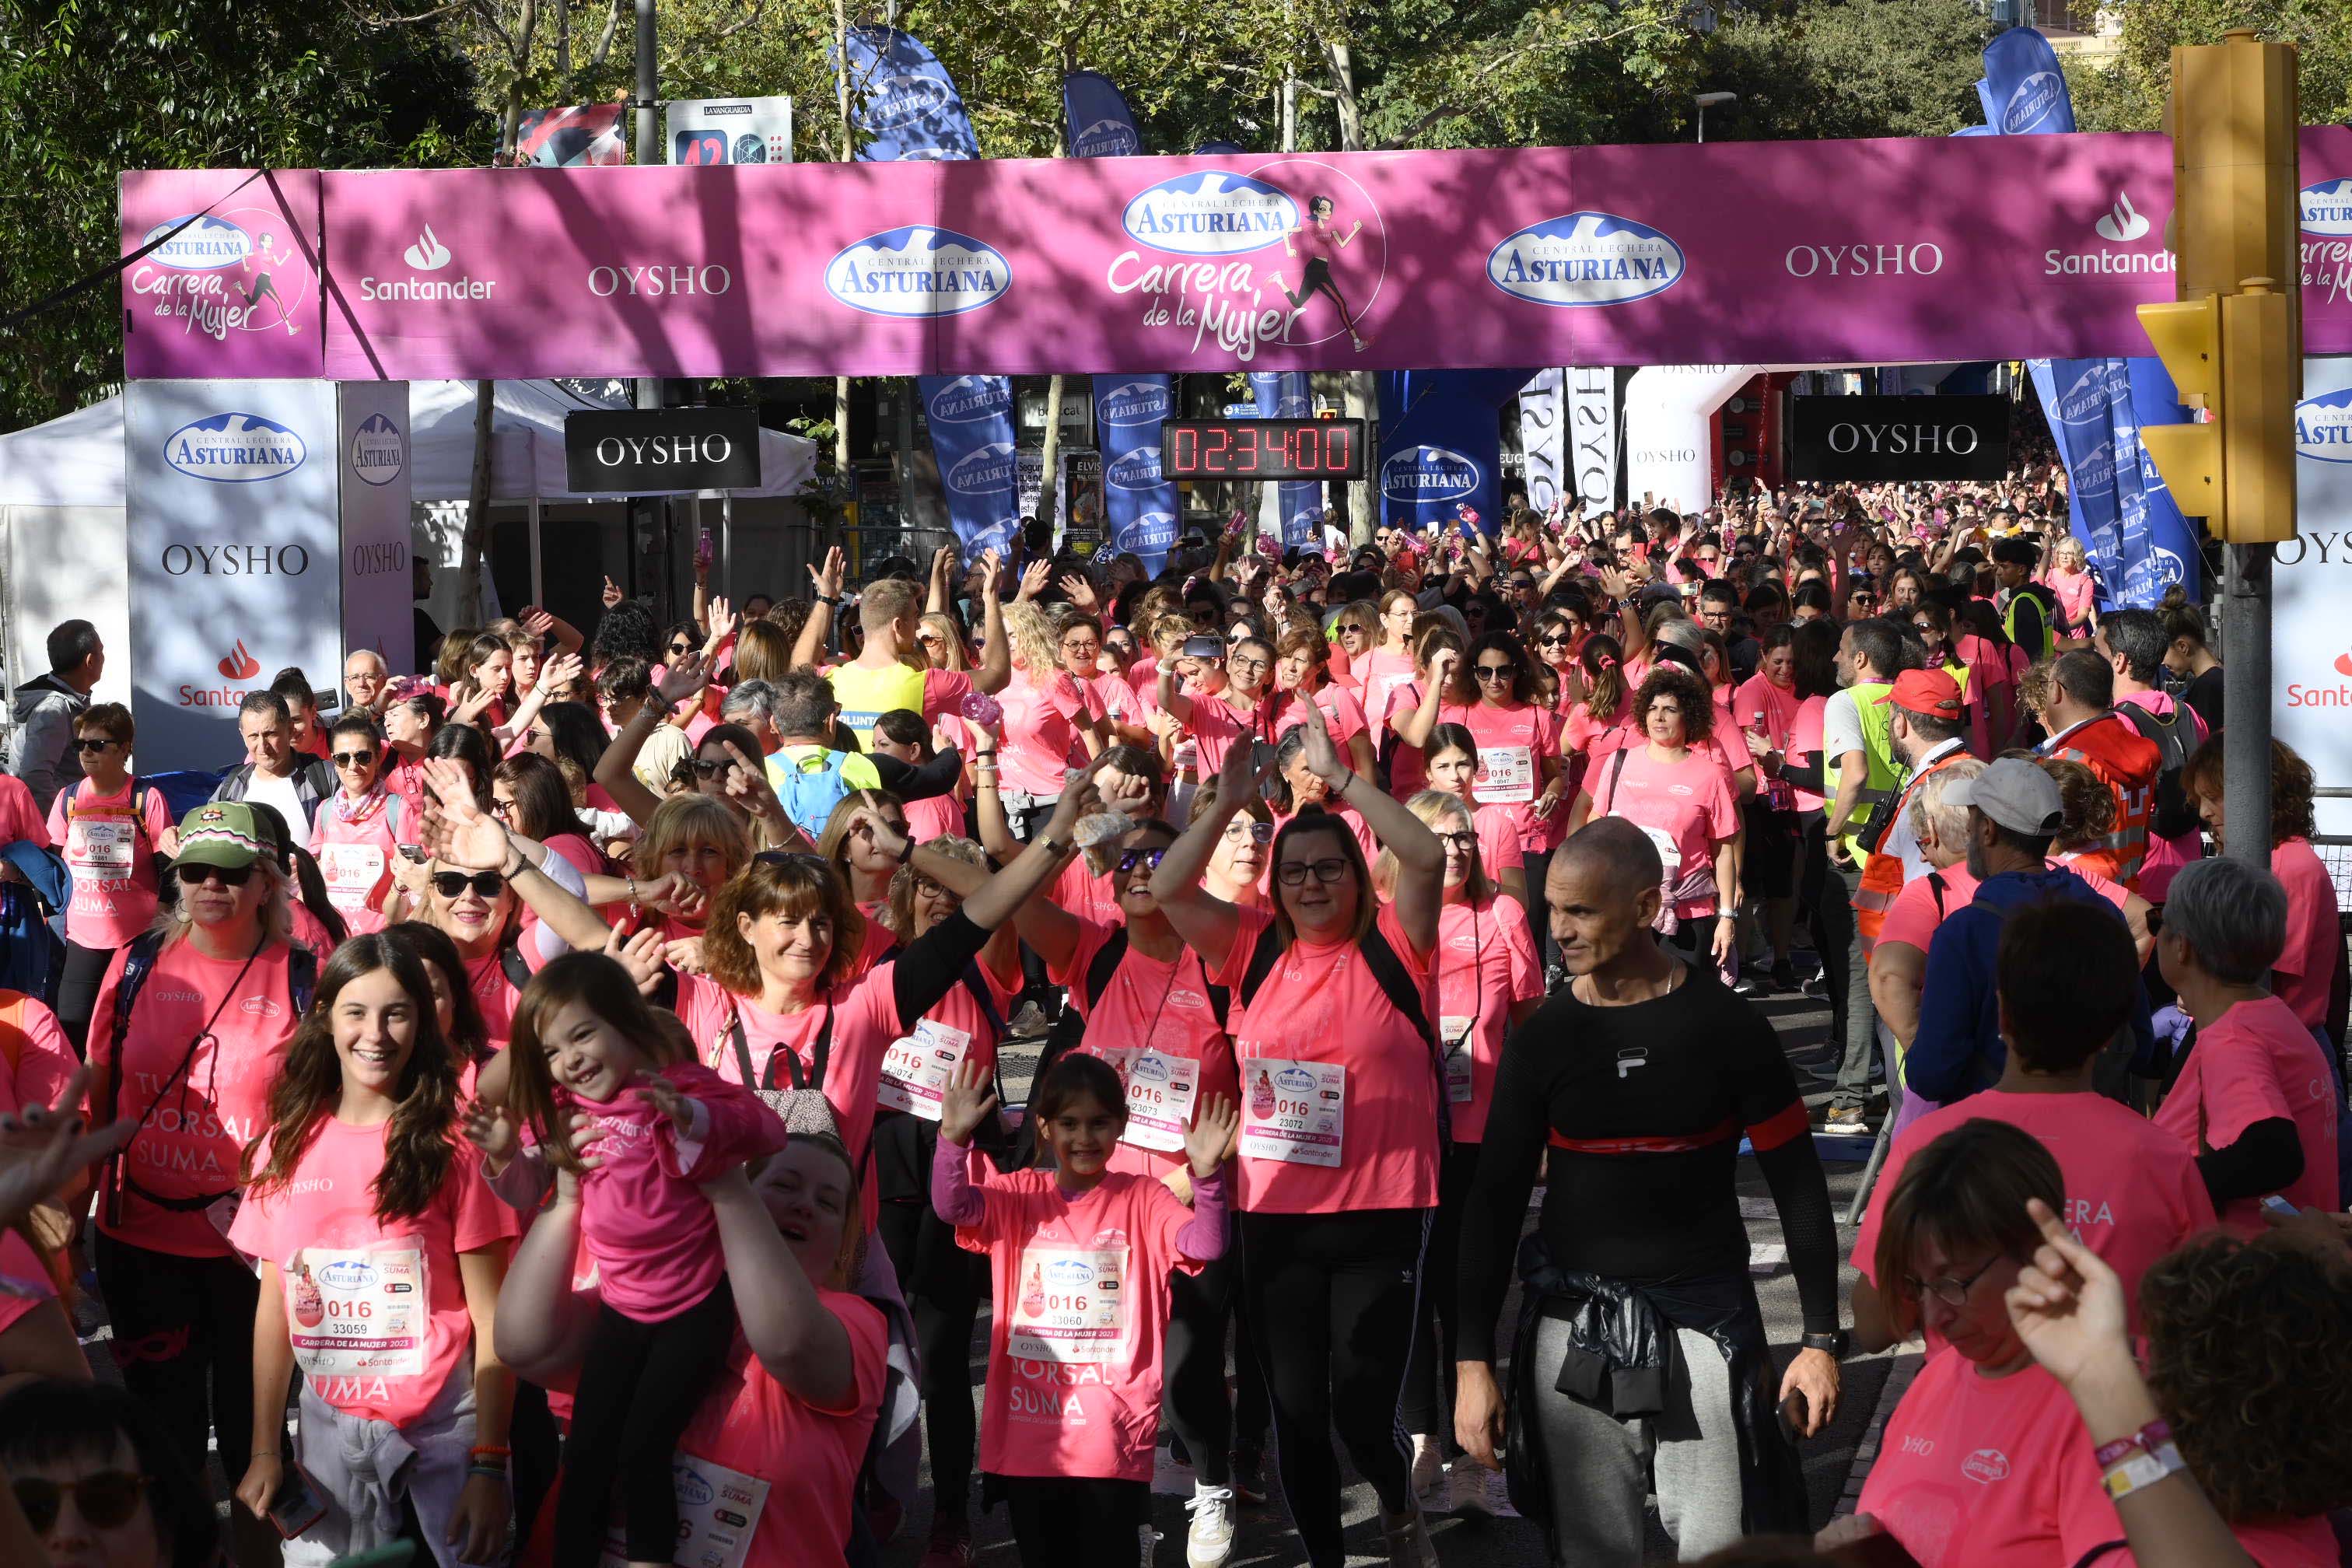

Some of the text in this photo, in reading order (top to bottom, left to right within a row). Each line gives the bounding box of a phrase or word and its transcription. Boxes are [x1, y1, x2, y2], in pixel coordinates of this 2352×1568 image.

[1224, 198, 1281, 208] LECHERA
[1136, 204, 1285, 234] ASTURIANA
[1531, 243, 1663, 255] CENTRAL LECHERA
[867, 256, 991, 266] CENTRAL LECHERA
[1501, 248, 1670, 283] ASTURIANA
[1785, 243, 1943, 278] OYSHO
[131, 265, 224, 296] Carrera
[588, 264, 731, 296] OYSHO
[840, 261, 997, 293] ASTURIANA
[1108, 251, 1253, 294] Carrera
[360, 276, 496, 302] Santander
[155, 291, 258, 341] de la Mujer
[1143, 289, 1307, 361] de la Mujer
[1828, 422, 1978, 454] OYSHO
[175, 439, 296, 465] ASTURIANA
[355, 440, 401, 468] ASTURIANA
[597, 434, 732, 467] OYSHO
[1175, 429, 1349, 471] 02:34:00
[1636, 449, 1696, 464] OYSHO
[1019, 461, 1044, 473] Segur
[1020, 485, 1043, 494] quiere
[1384, 470, 1472, 491] ASTURIANA
[162, 544, 309, 576] OYSHO
[353, 541, 404, 576] OYSHO
[2287, 684, 2352, 706] Sant
[1491, 768, 1512, 777] 016
[89, 844, 110, 853] 016
[75, 897, 117, 912] SUMA
[156, 991, 203, 1003] OYSHO
[939, 1037, 958, 1048] SUMA
[888, 1048, 922, 1069] 016
[886, 1065, 914, 1080] 23074
[1278, 1076, 1313, 1088] ASTURIANA
[1132, 1085, 1162, 1104] 016
[1132, 1103, 1158, 1116] 23073
[1279, 1100, 1309, 1115] 016
[142, 1108, 254, 1142] DORSAL
[1279, 1118, 1304, 1129] 23072
[1254, 1129, 1279, 1137] CARRERA
[1295, 1133, 1317, 1142] MUJER
[138, 1142, 222, 1173] SUMA
[1300, 1147, 1333, 1158] Santander
[324, 1271, 374, 1283] ASTURIANA
[328, 1300, 372, 1318] 016
[1049, 1295, 1087, 1311] 016
[333, 1324, 367, 1334] 33059
[1027, 1328, 1053, 1336] CARRERA
[1020, 1342, 1052, 1353] OYSHO
[1010, 1386, 1083, 1416] SUMA
[721, 1489, 752, 1507] SUMA
